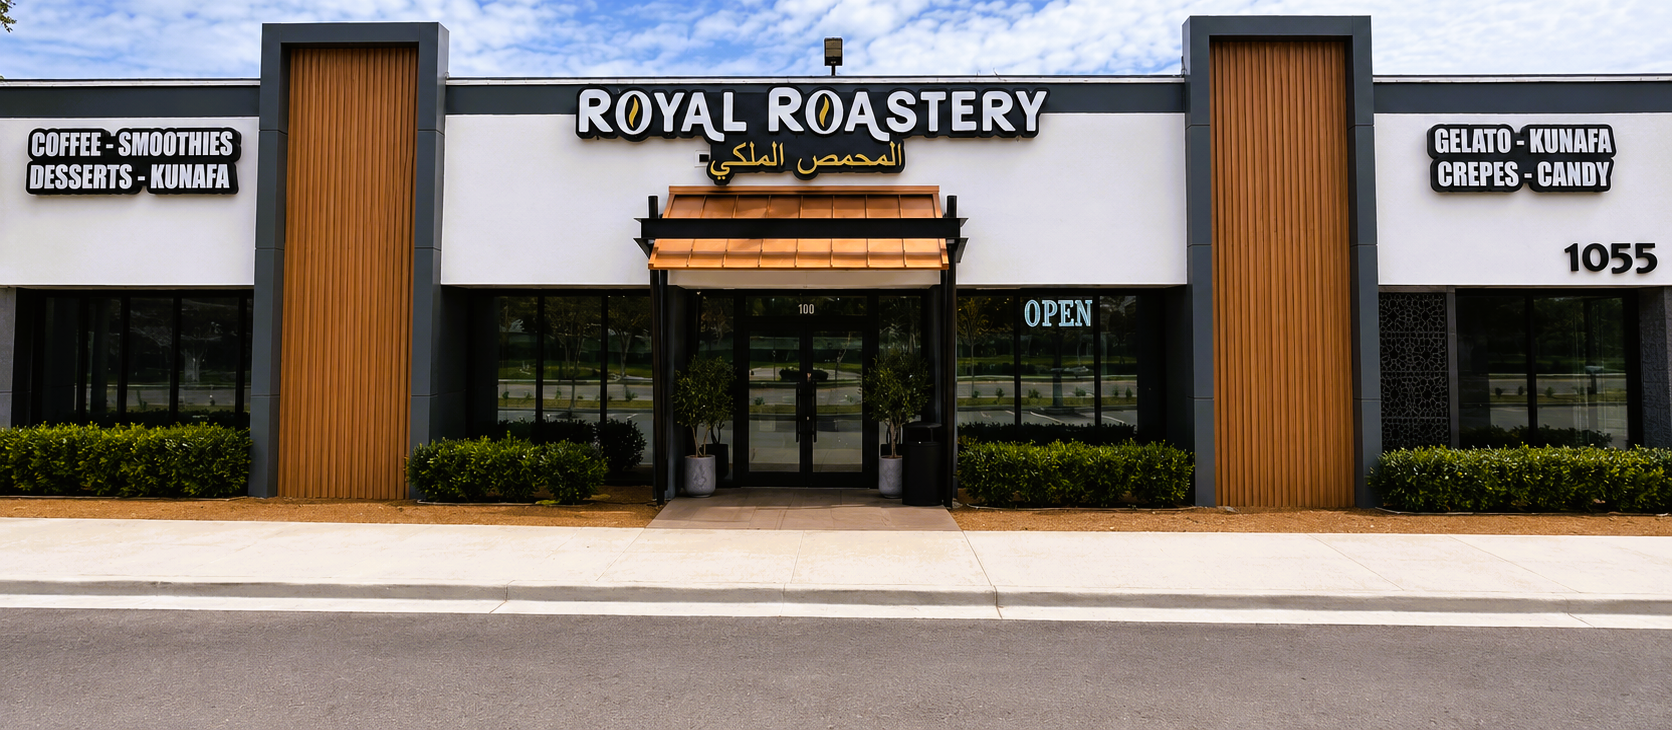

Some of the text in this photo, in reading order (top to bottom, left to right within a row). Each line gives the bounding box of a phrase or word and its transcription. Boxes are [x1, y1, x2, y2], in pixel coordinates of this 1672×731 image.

[579, 86, 1048, 142] ROYAL ROASTERY
[31, 131, 101, 157] COFFEE
[118, 131, 233, 157] SMOOTHIES
[1434, 128, 1512, 153] GELATO
[1529, 128, 1613, 153] KUNAFA
[709, 141, 903, 181] المحمص الملكي
[1437, 161, 1519, 187] CREPES
[1537, 161, 1610, 187] CANDY
[29, 164, 133, 190] DESSERTS
[150, 163, 230, 189] KUNAFA
[1564, 242, 1658, 274] 1055
[798, 304, 815, 315] 100
[1024, 299, 1093, 327] OPEN
